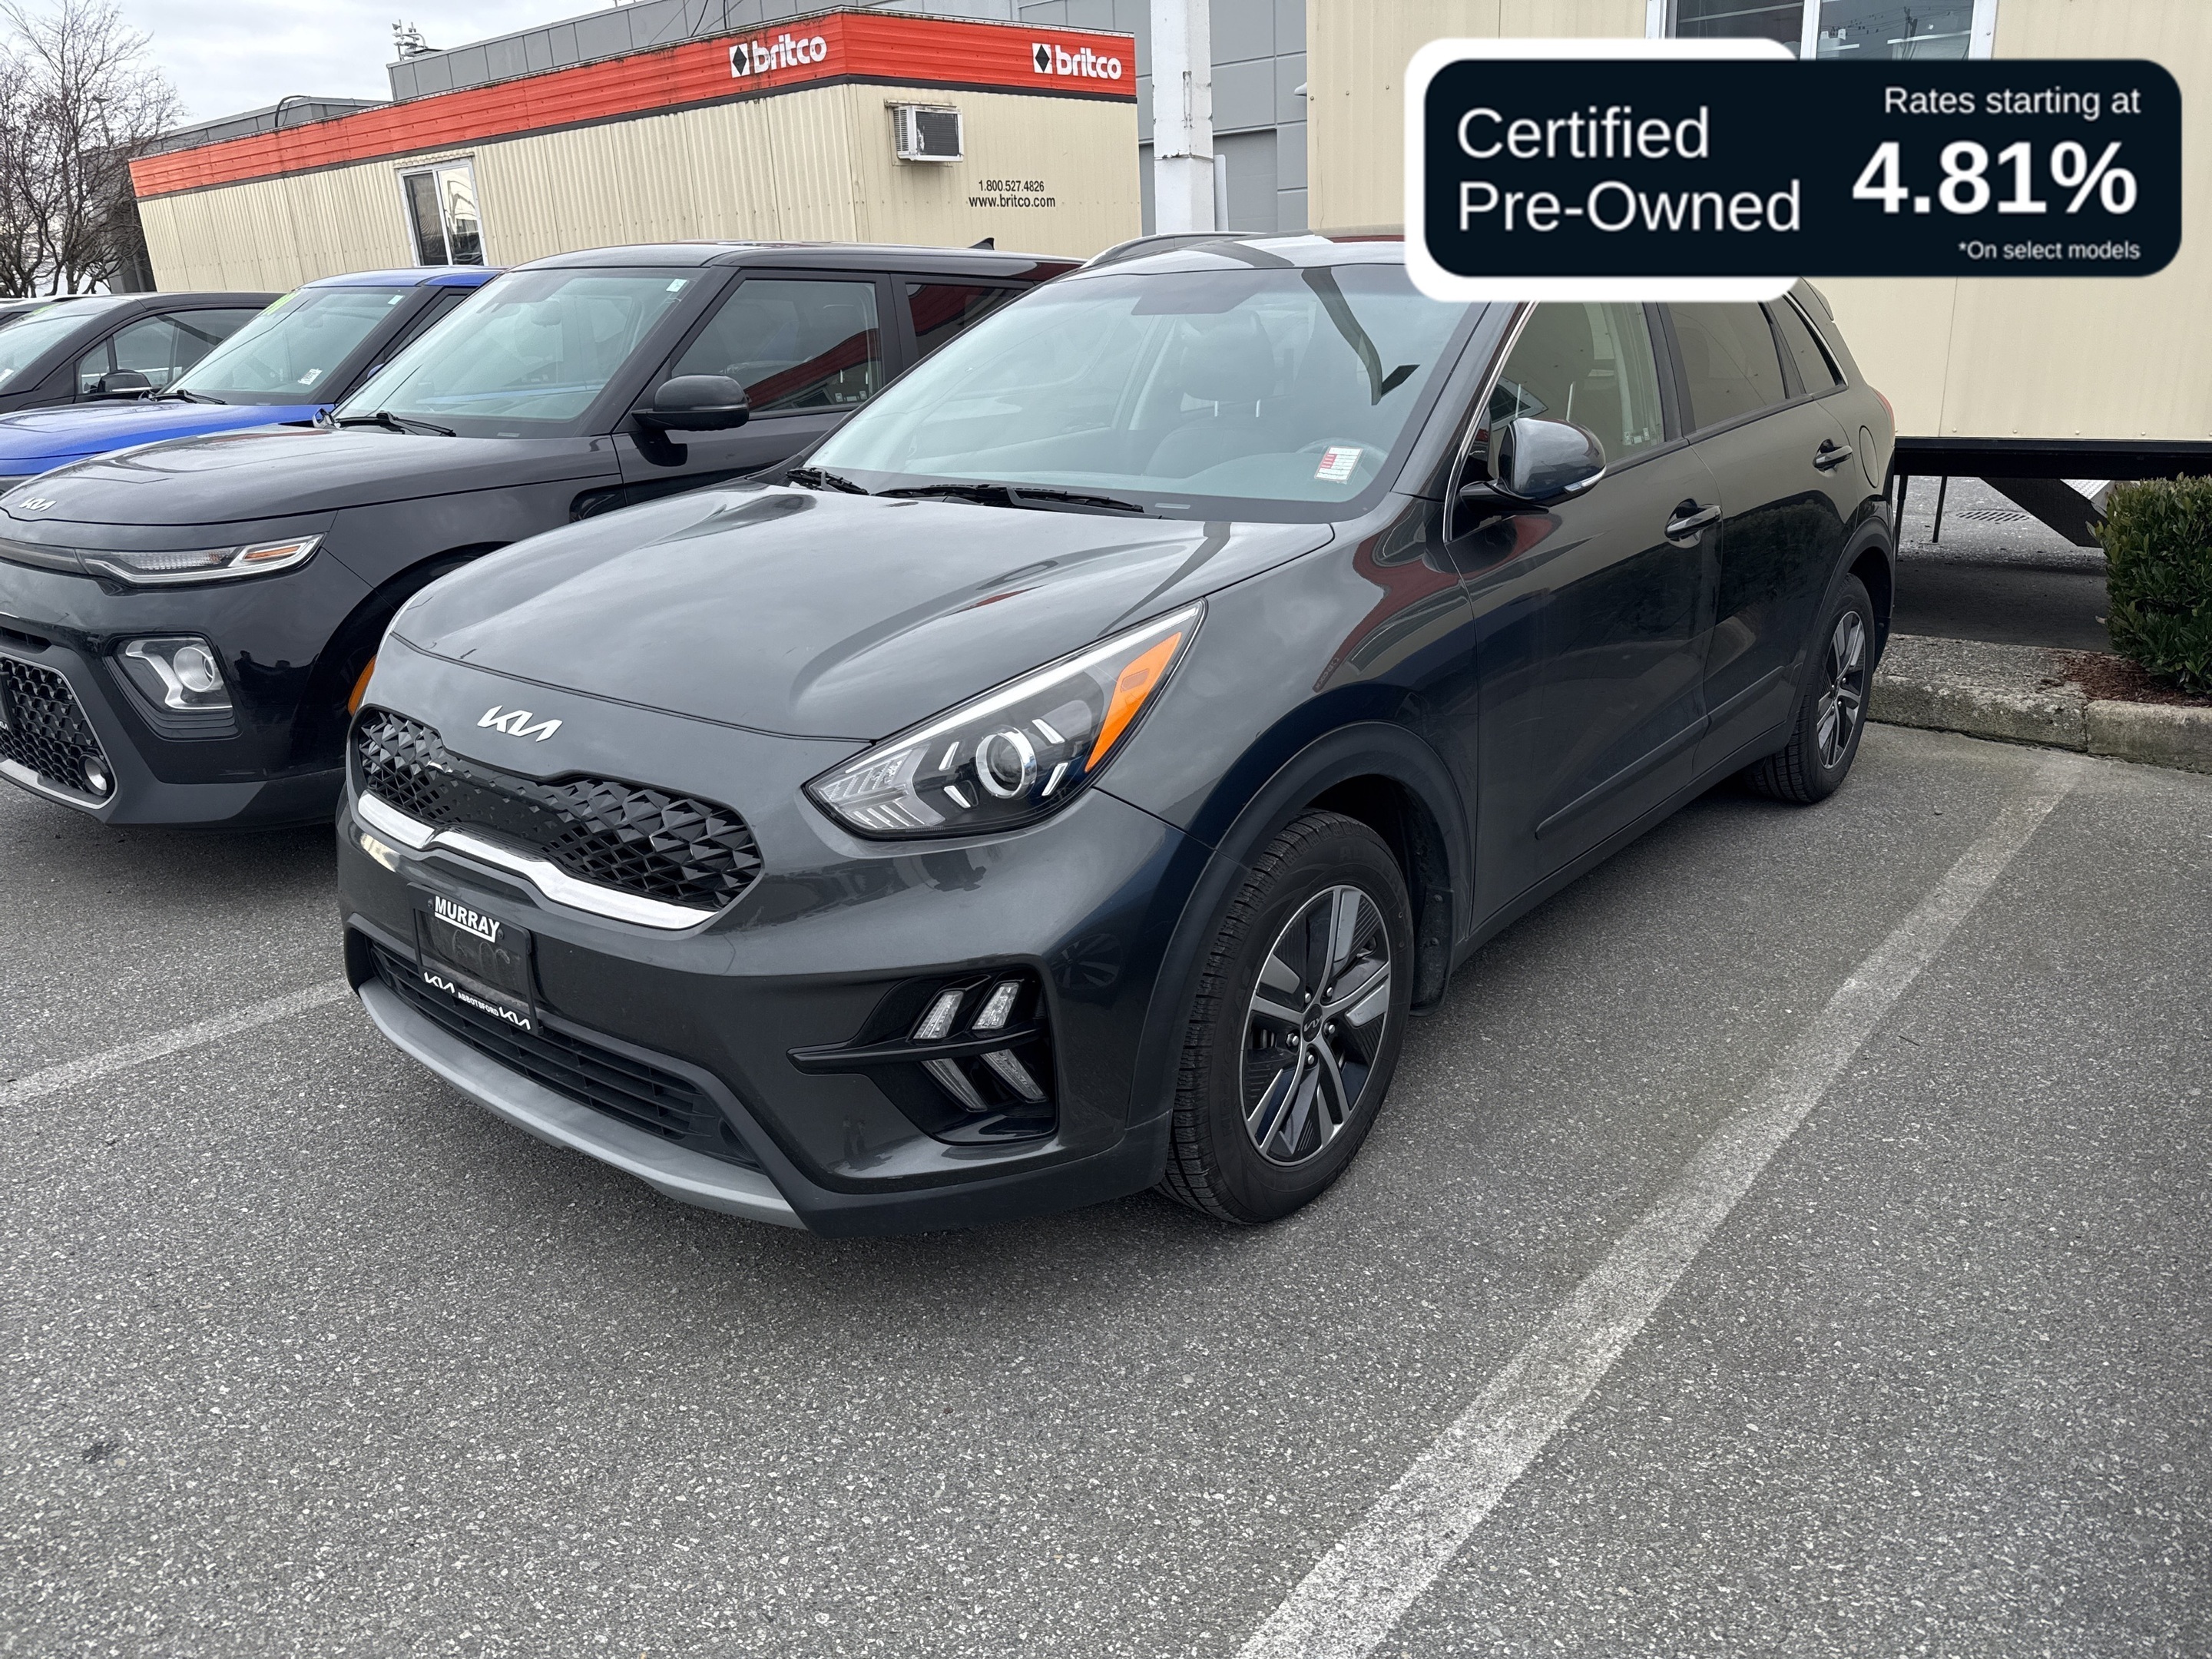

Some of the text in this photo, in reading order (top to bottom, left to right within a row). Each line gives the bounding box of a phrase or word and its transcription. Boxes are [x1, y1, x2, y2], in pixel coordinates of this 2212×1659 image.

[752, 33, 827, 74] britco
[1055, 45, 1121, 80] britco
[969, 194, 1056, 207] www.britco.com
[979, 179, 1045, 192] 1.800.527.4826
[18, 497, 58, 512] KIA
[477, 705, 563, 743] KIA
[435, 896, 501, 942] MURRAY
[424, 972, 531, 1031] KIA ABBOTSFORD KIA
